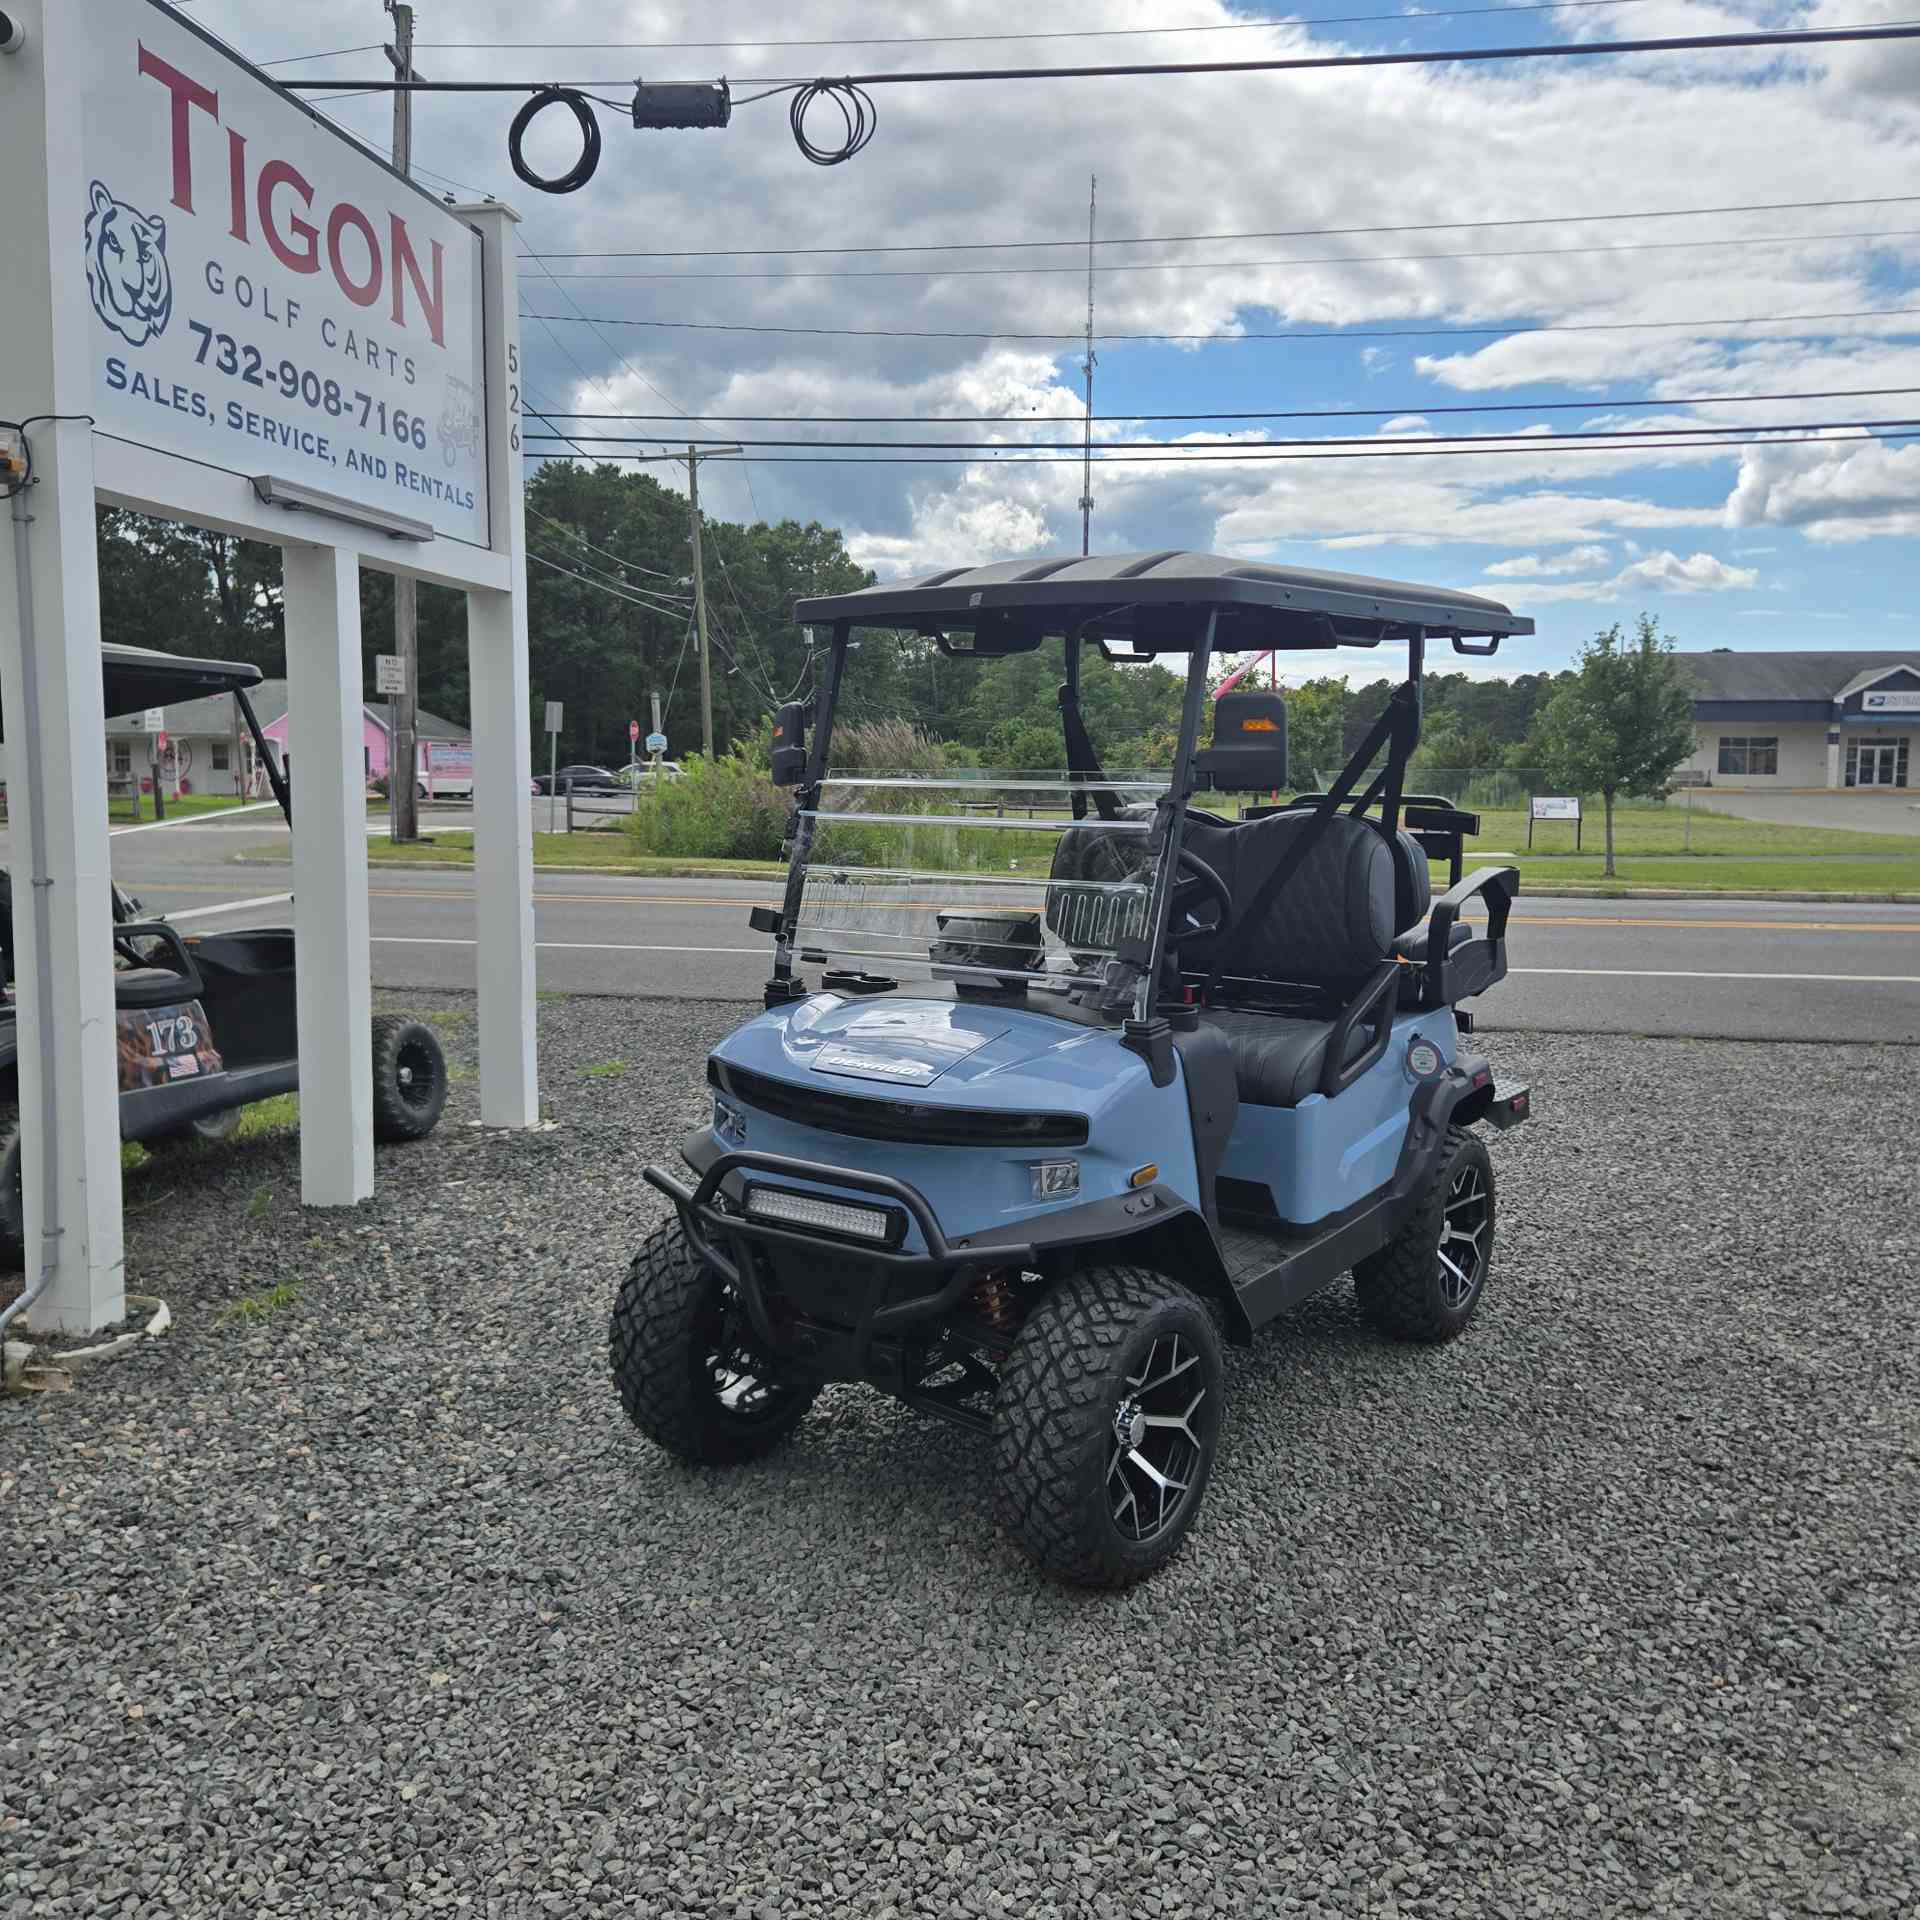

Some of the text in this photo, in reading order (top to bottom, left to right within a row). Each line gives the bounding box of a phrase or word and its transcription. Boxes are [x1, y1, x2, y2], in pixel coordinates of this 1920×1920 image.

[138, 38, 447, 349] TIGON
[188, 319, 427, 450] 732-908-7166
[205, 260, 416, 385] GOLF CARTS
[105, 357, 475, 510] SALES, SERVICE, AND RENTALS
[146, 1015, 198, 1056] 173
